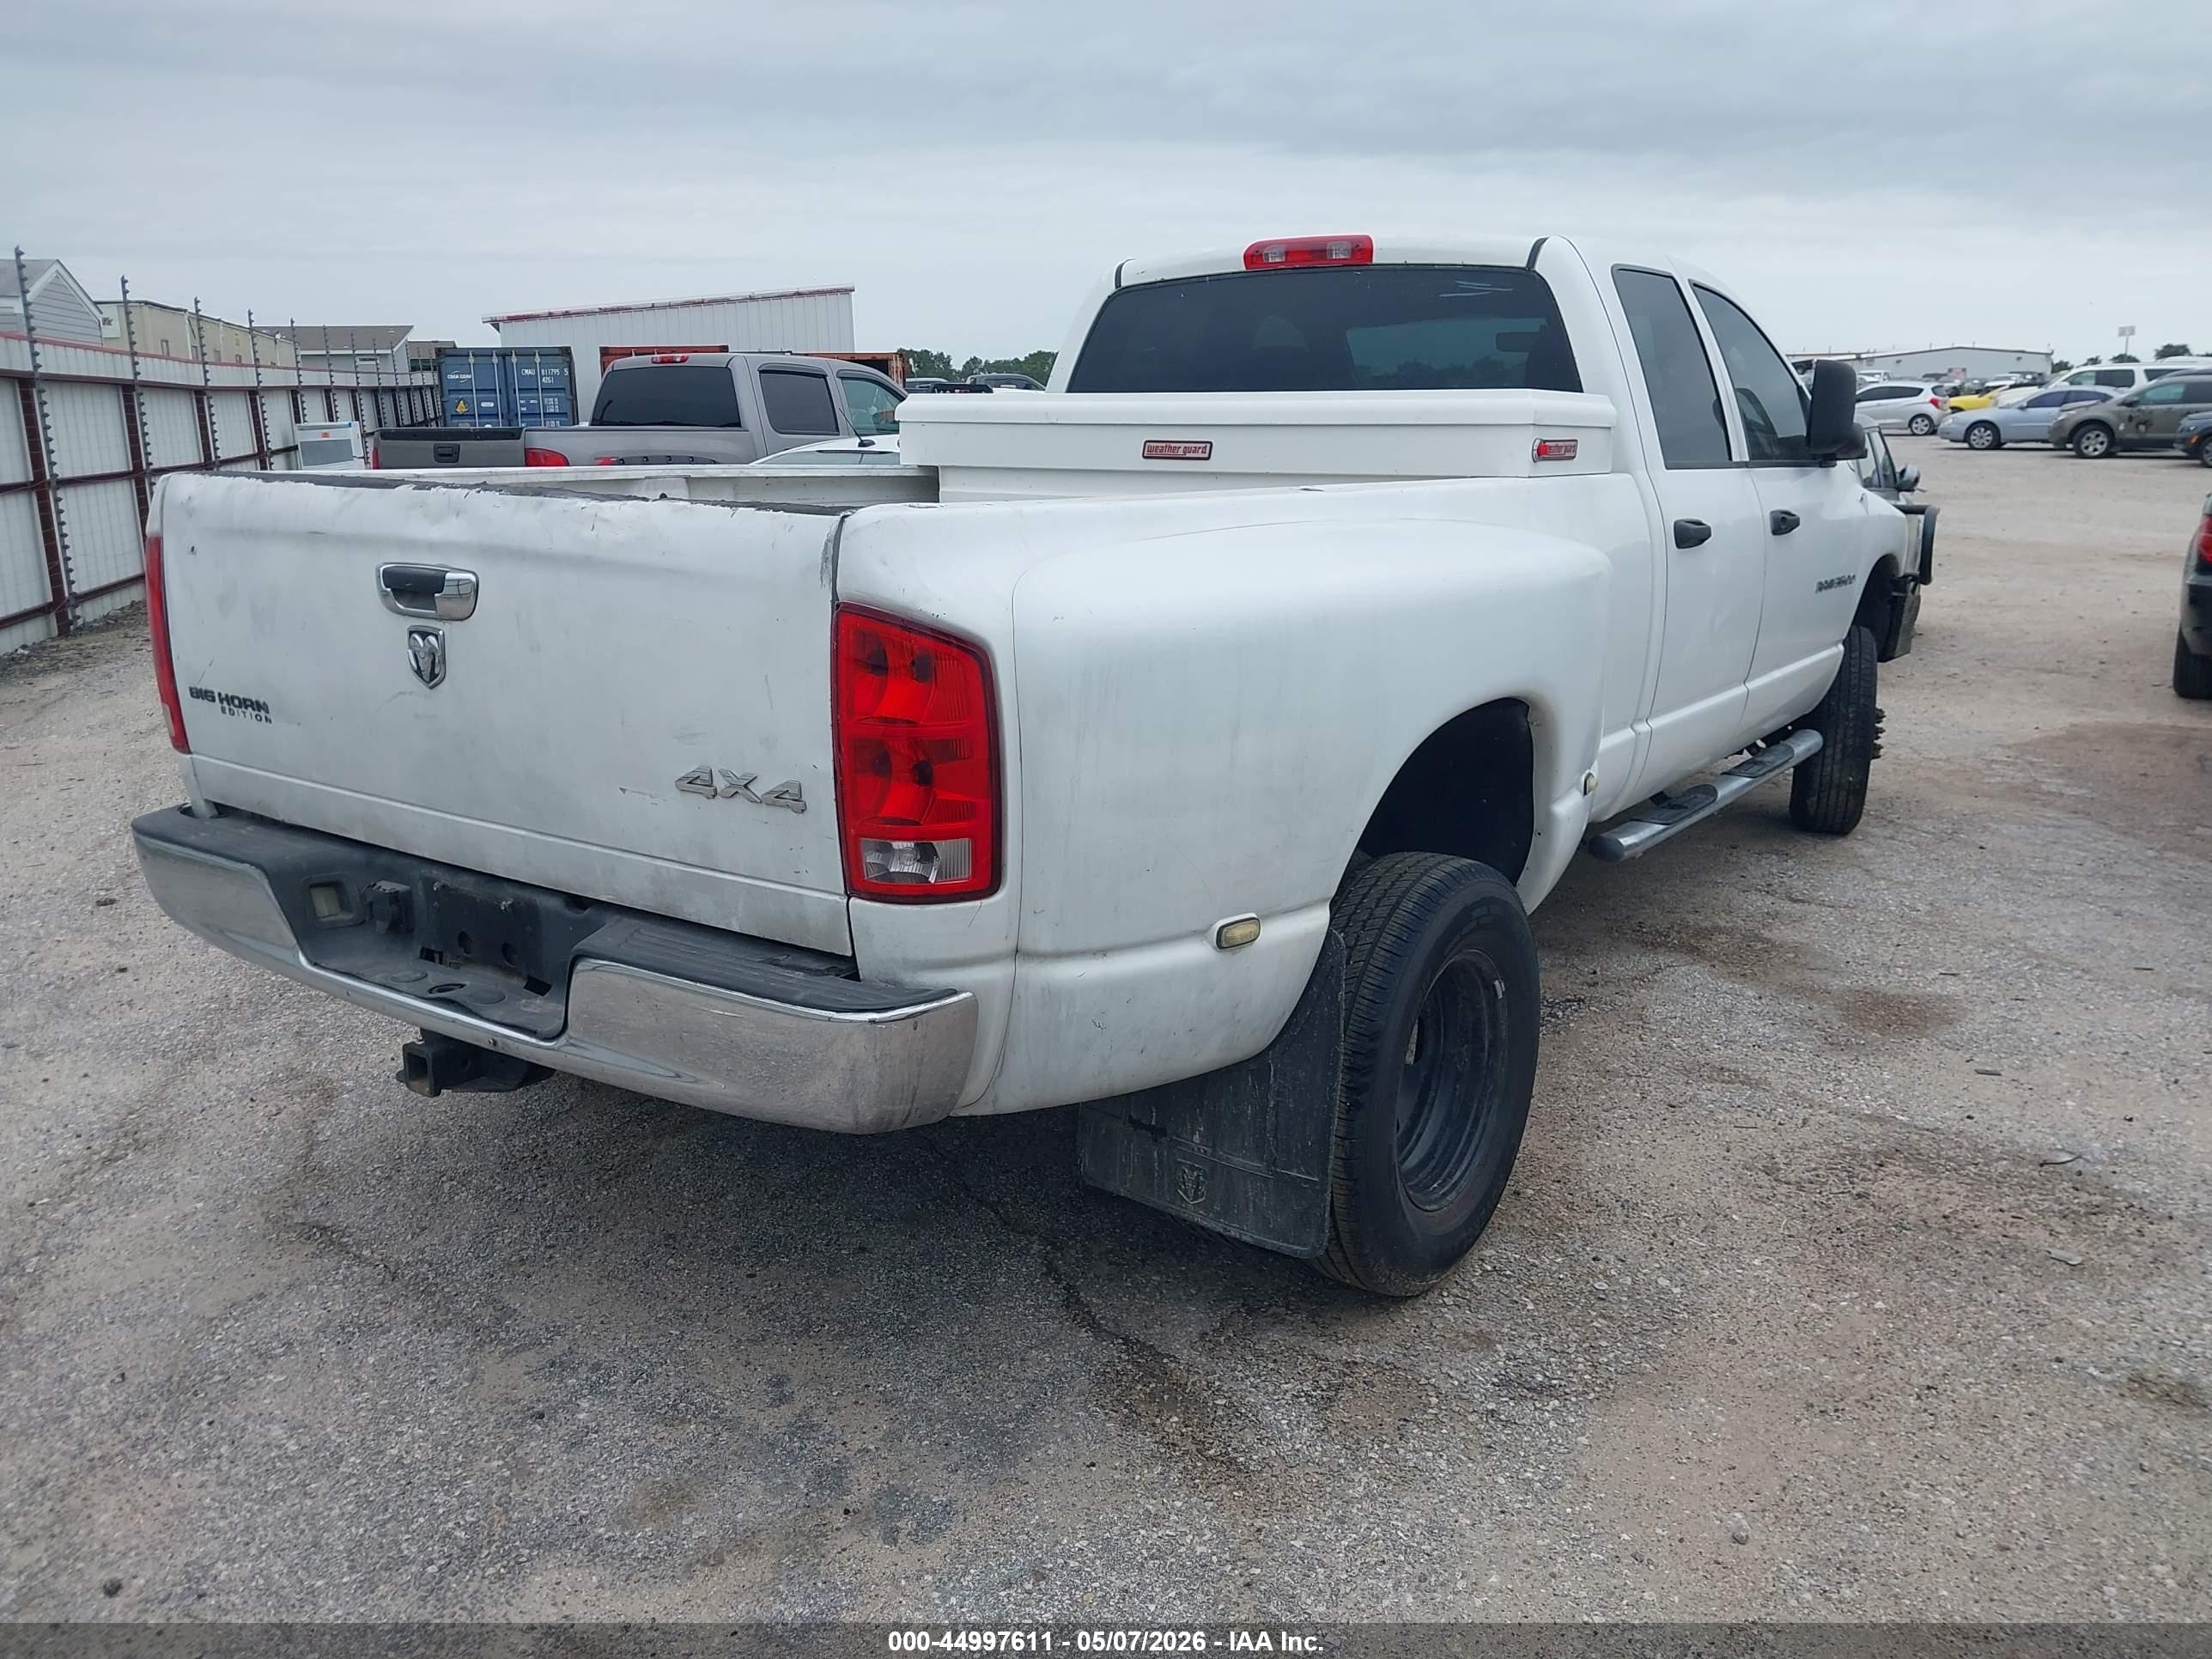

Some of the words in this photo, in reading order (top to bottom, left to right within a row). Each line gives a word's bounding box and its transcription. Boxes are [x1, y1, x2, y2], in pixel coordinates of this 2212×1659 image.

[1146, 443, 1182, 454] weather
[1182, 444, 1208, 456] guard
[188, 686, 216, 703] BIG
[217, 691, 270, 715] HORN
[220, 705, 273, 725] EDITION
